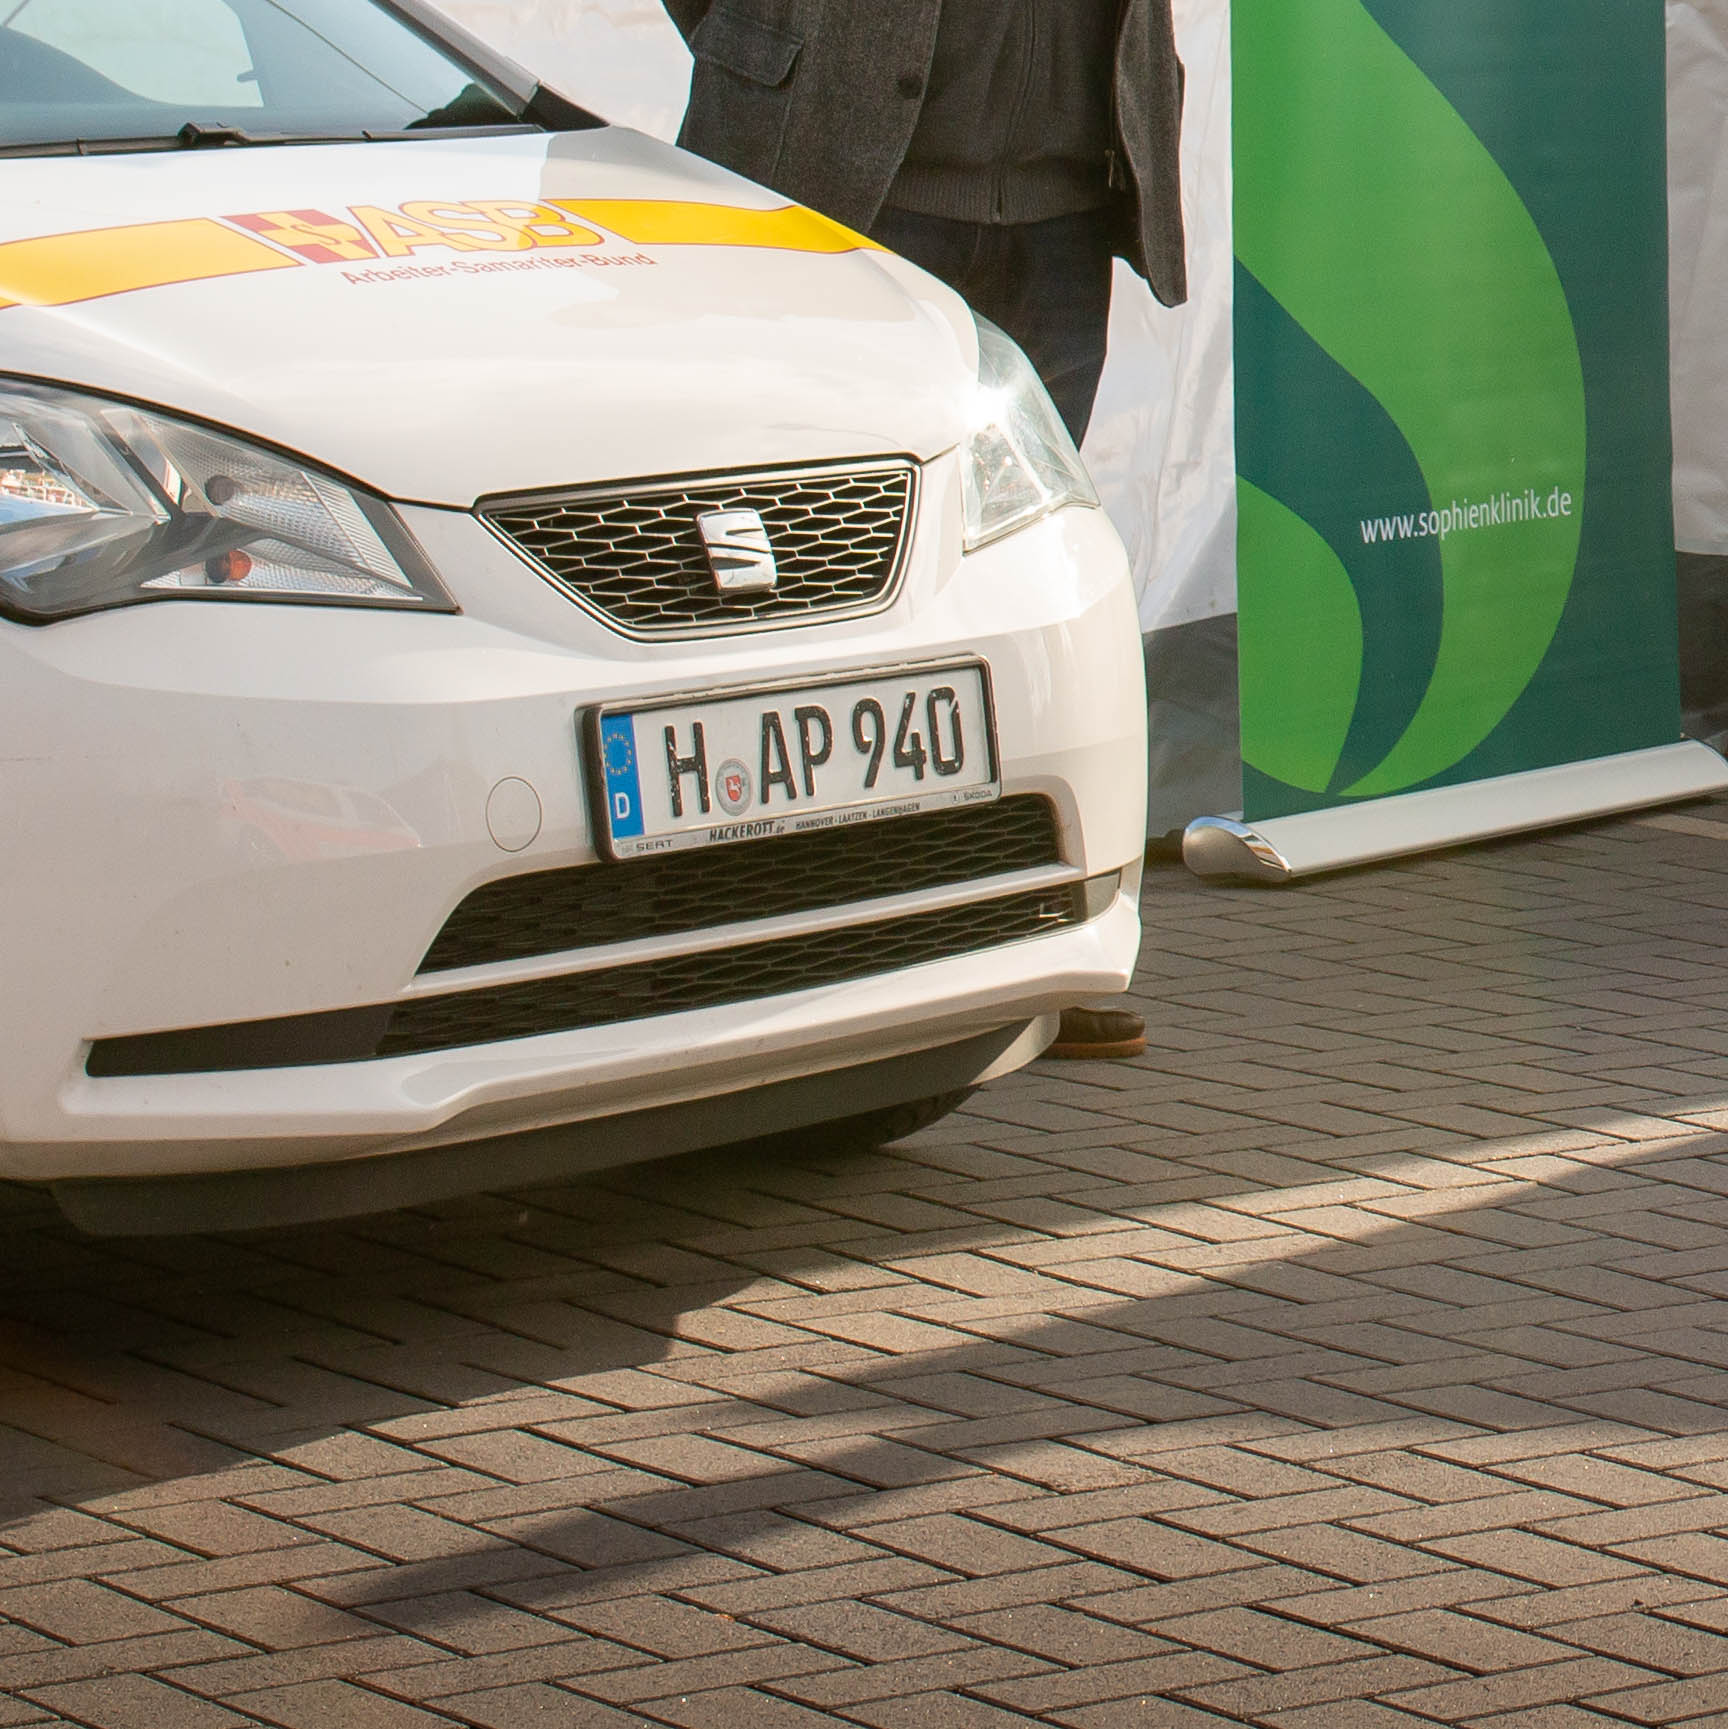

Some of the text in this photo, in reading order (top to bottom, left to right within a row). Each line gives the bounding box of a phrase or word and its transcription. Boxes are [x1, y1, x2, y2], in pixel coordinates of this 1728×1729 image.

[345, 198, 606, 258] ASB
[340, 251, 659, 286] Arbeiter-Samariter-Bund
[1359, 485, 1573, 544] www.sophienklinik.de
[663, 685, 965, 818] H AP 940
[613, 791, 631, 819] D
[709, 820, 786, 843] HACKEROTT.de
[795, 816, 835, 831] HANNOVER
